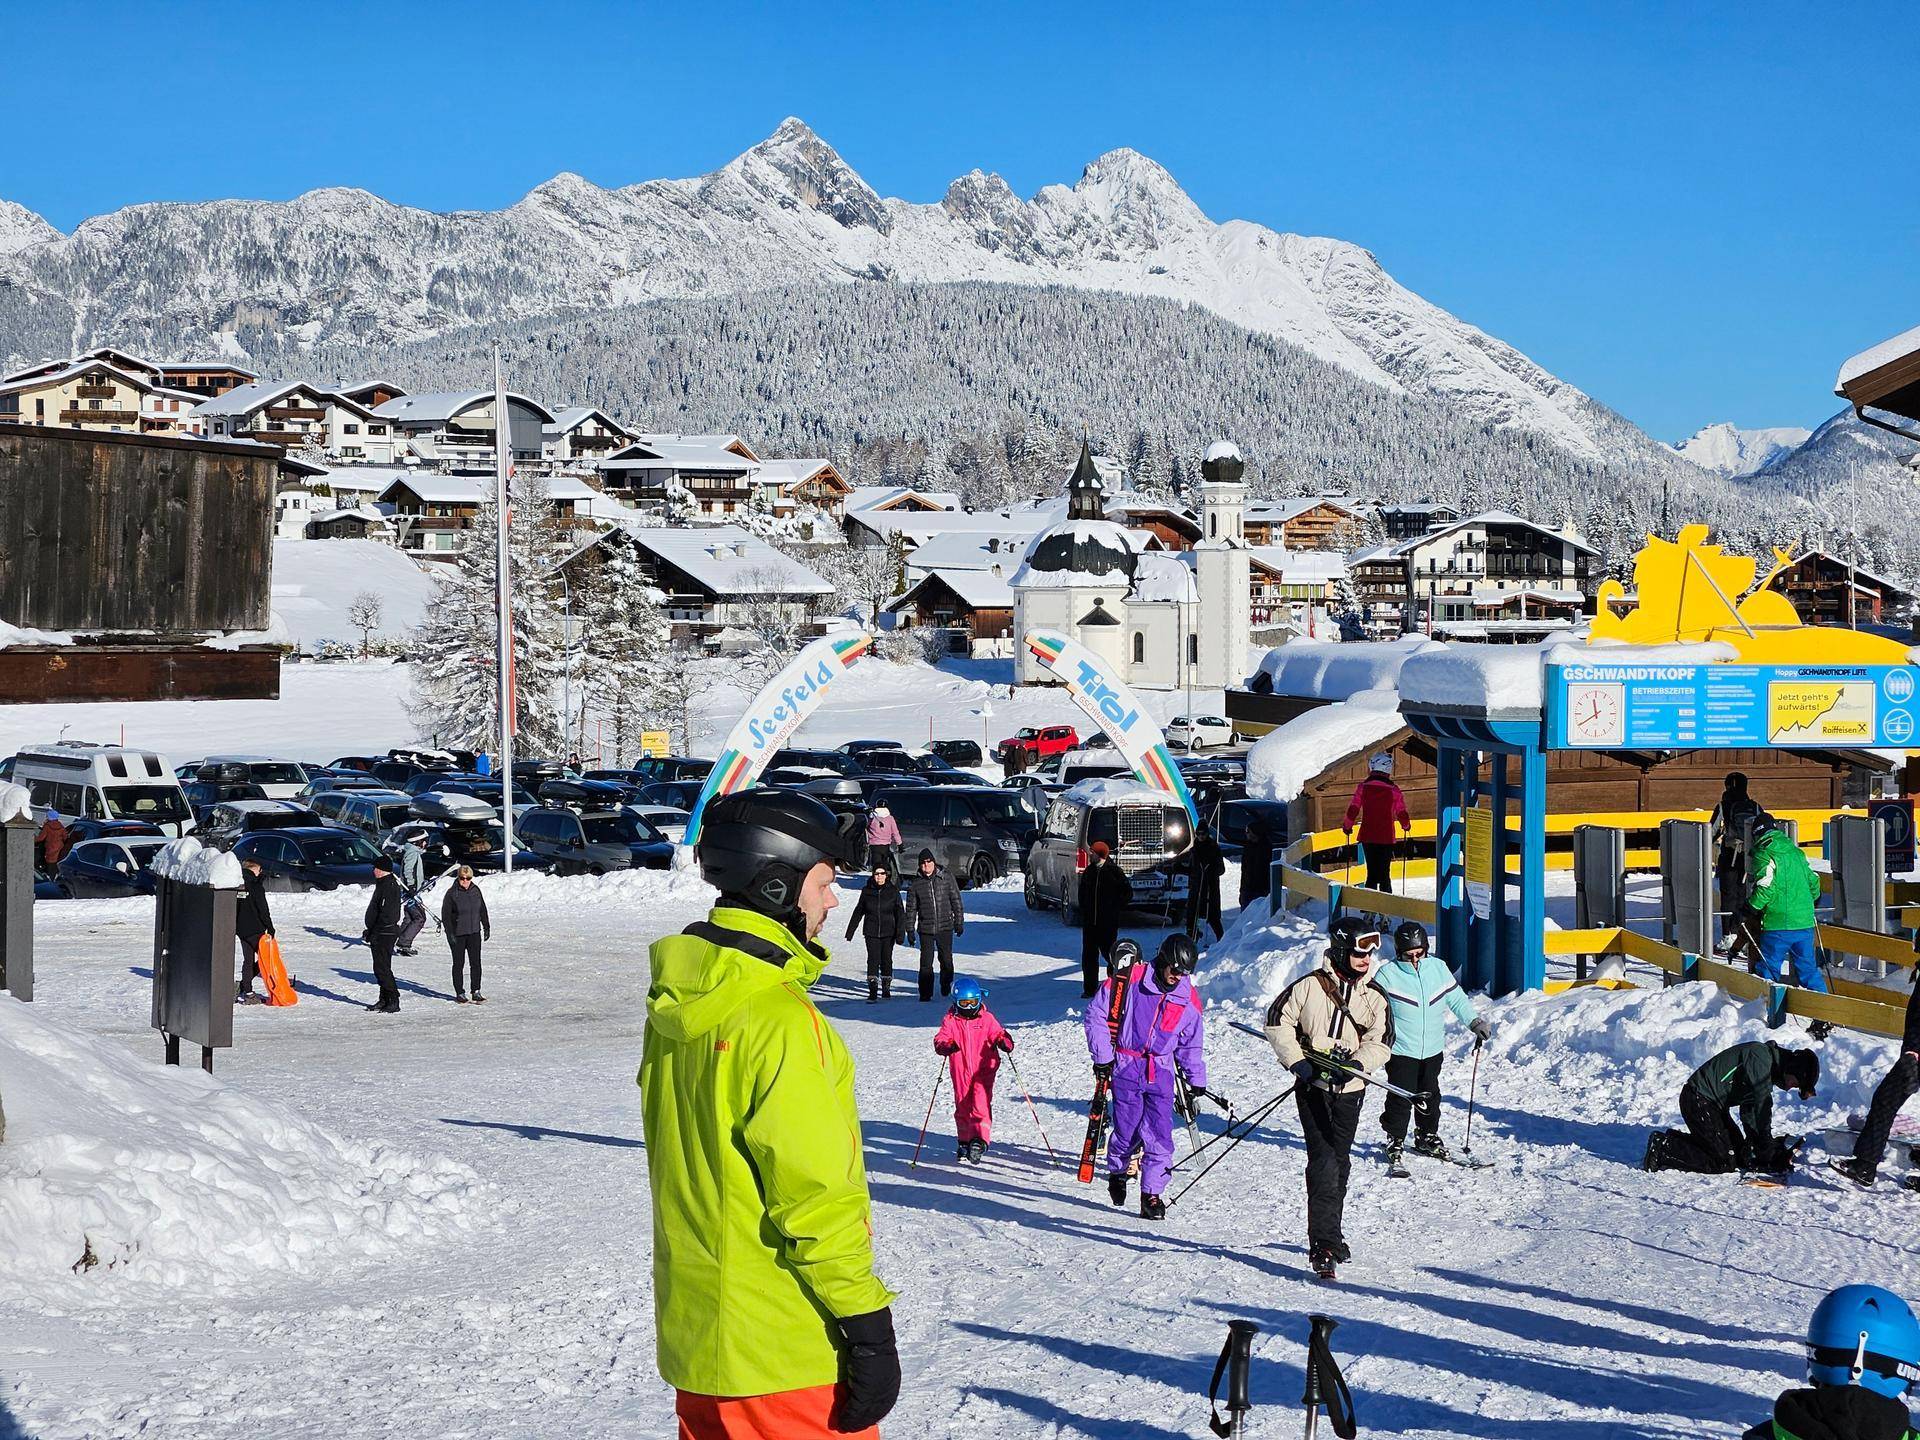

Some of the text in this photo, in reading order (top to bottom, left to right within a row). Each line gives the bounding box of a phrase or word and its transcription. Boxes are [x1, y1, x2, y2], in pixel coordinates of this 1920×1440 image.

[1563, 668, 1696, 680] GSCHWANDTKOPF
[749, 660, 834, 750] Seefeld
[1077, 660, 1140, 732] Tirol
[1632, 687, 1695, 695] BETRIEBSZEITEN
[1777, 693, 1829, 703] Jetzt geht's
[1079, 696, 1129, 748] GSCHWANDTKOPF
[1822, 726, 1857, 734] Raiffeisen
[754, 712, 803, 770] GSCHWANDTKOPF
